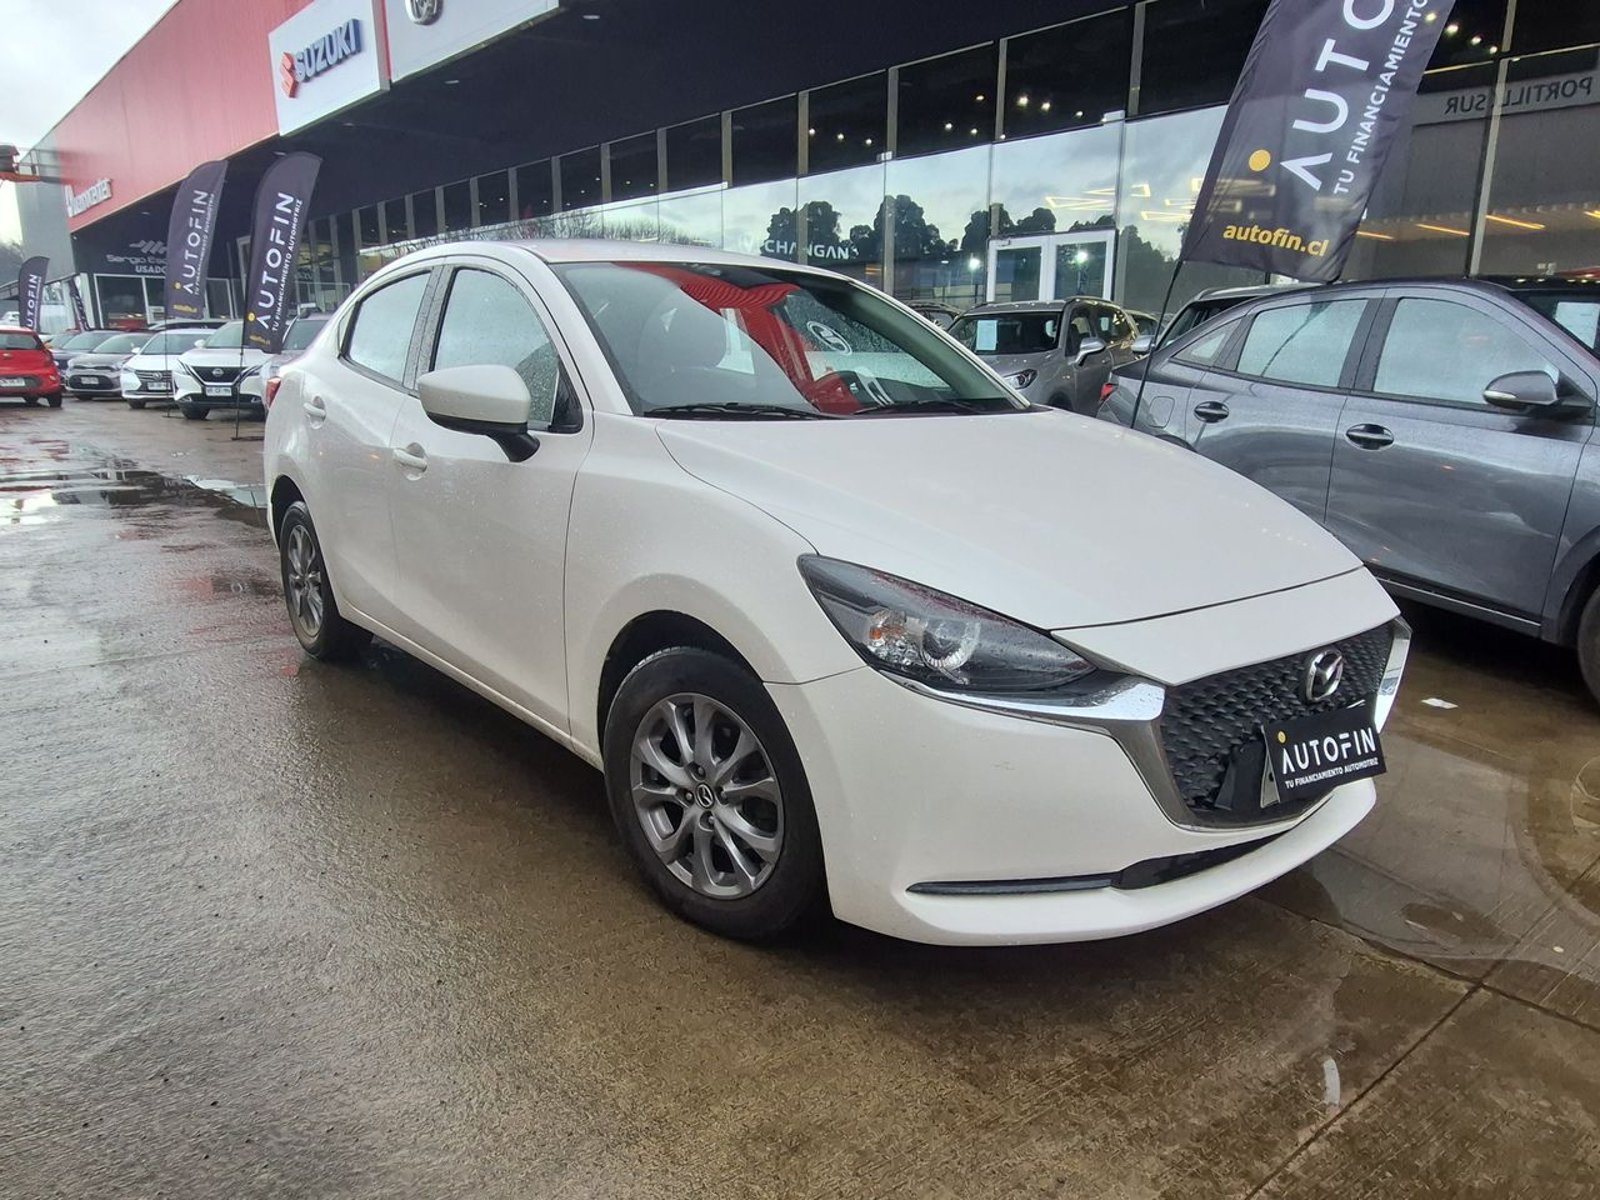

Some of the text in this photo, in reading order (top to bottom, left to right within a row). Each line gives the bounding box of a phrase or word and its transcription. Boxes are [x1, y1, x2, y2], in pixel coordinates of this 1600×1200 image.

[294, 18, 360, 82] SUZUKI
[1333, 168, 1355, 195] TU
[182, 190, 208, 294] AUTOFIN
[255, 192, 294, 329] AUTOFIN
[276, 253, 292, 320] FINANCIAMIENTO
[287, 199, 303, 252] AUTOMOTRIZ
[1223, 224, 1329, 257] autofin.cl
[26, 274, 39, 327] UTOFIN
[1282, 727, 1376, 774] AUTOFIN
[1285, 757, 1378, 789] TU FINANCIAMIENTO AUTOMOTRIZ
